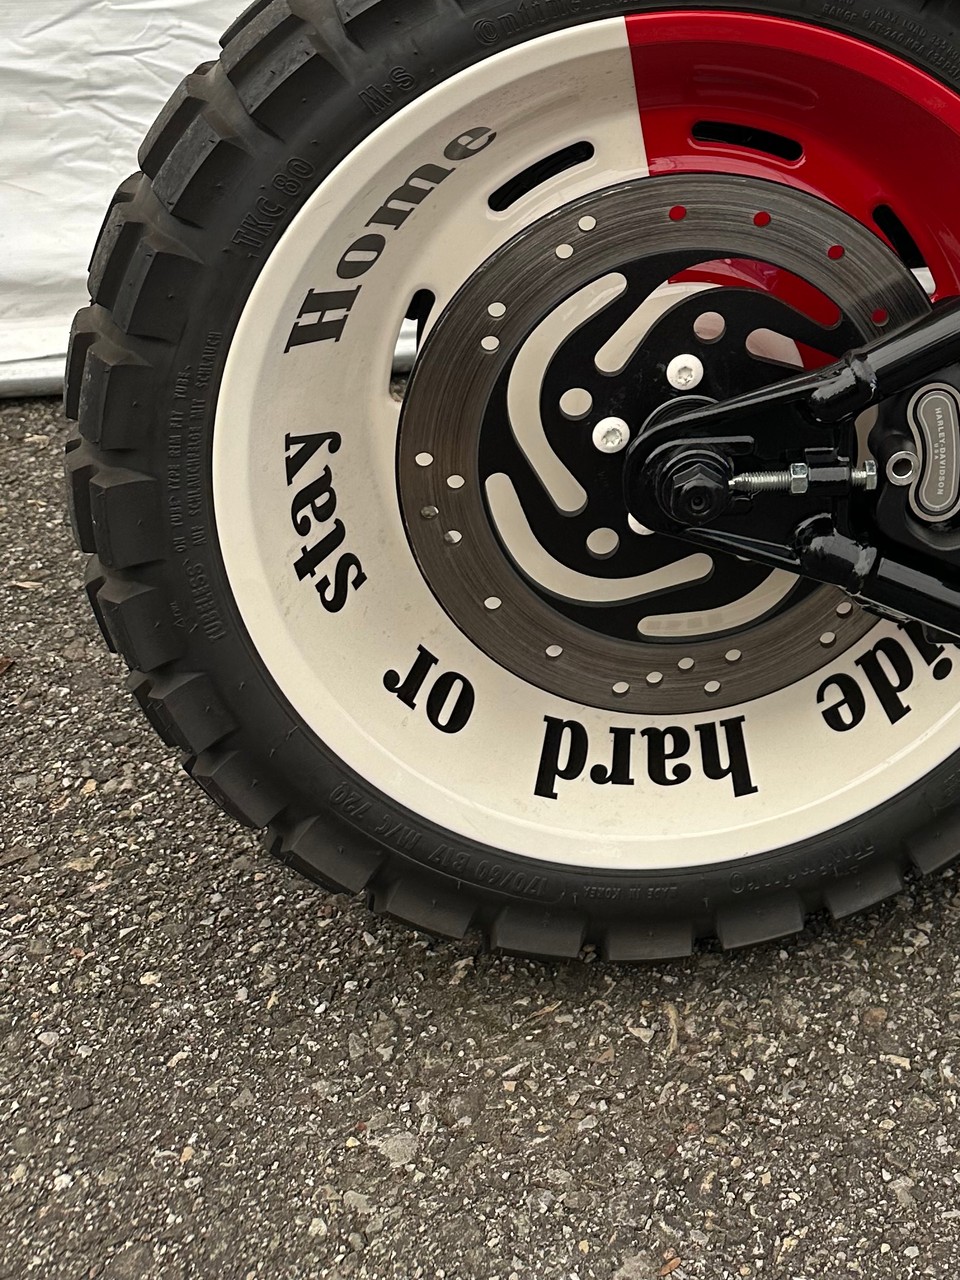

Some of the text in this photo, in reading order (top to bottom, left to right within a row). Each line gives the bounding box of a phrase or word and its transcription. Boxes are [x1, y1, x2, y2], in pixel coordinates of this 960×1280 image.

[231, 156, 316, 248] TKC 80
[284, 126, 498, 354] Home
[934, 406, 947, 496] HARLEY-DAVIDSON
[285, 431, 368, 614] stay
[383, 643, 475, 734] or
[534, 715, 759, 799] hard
